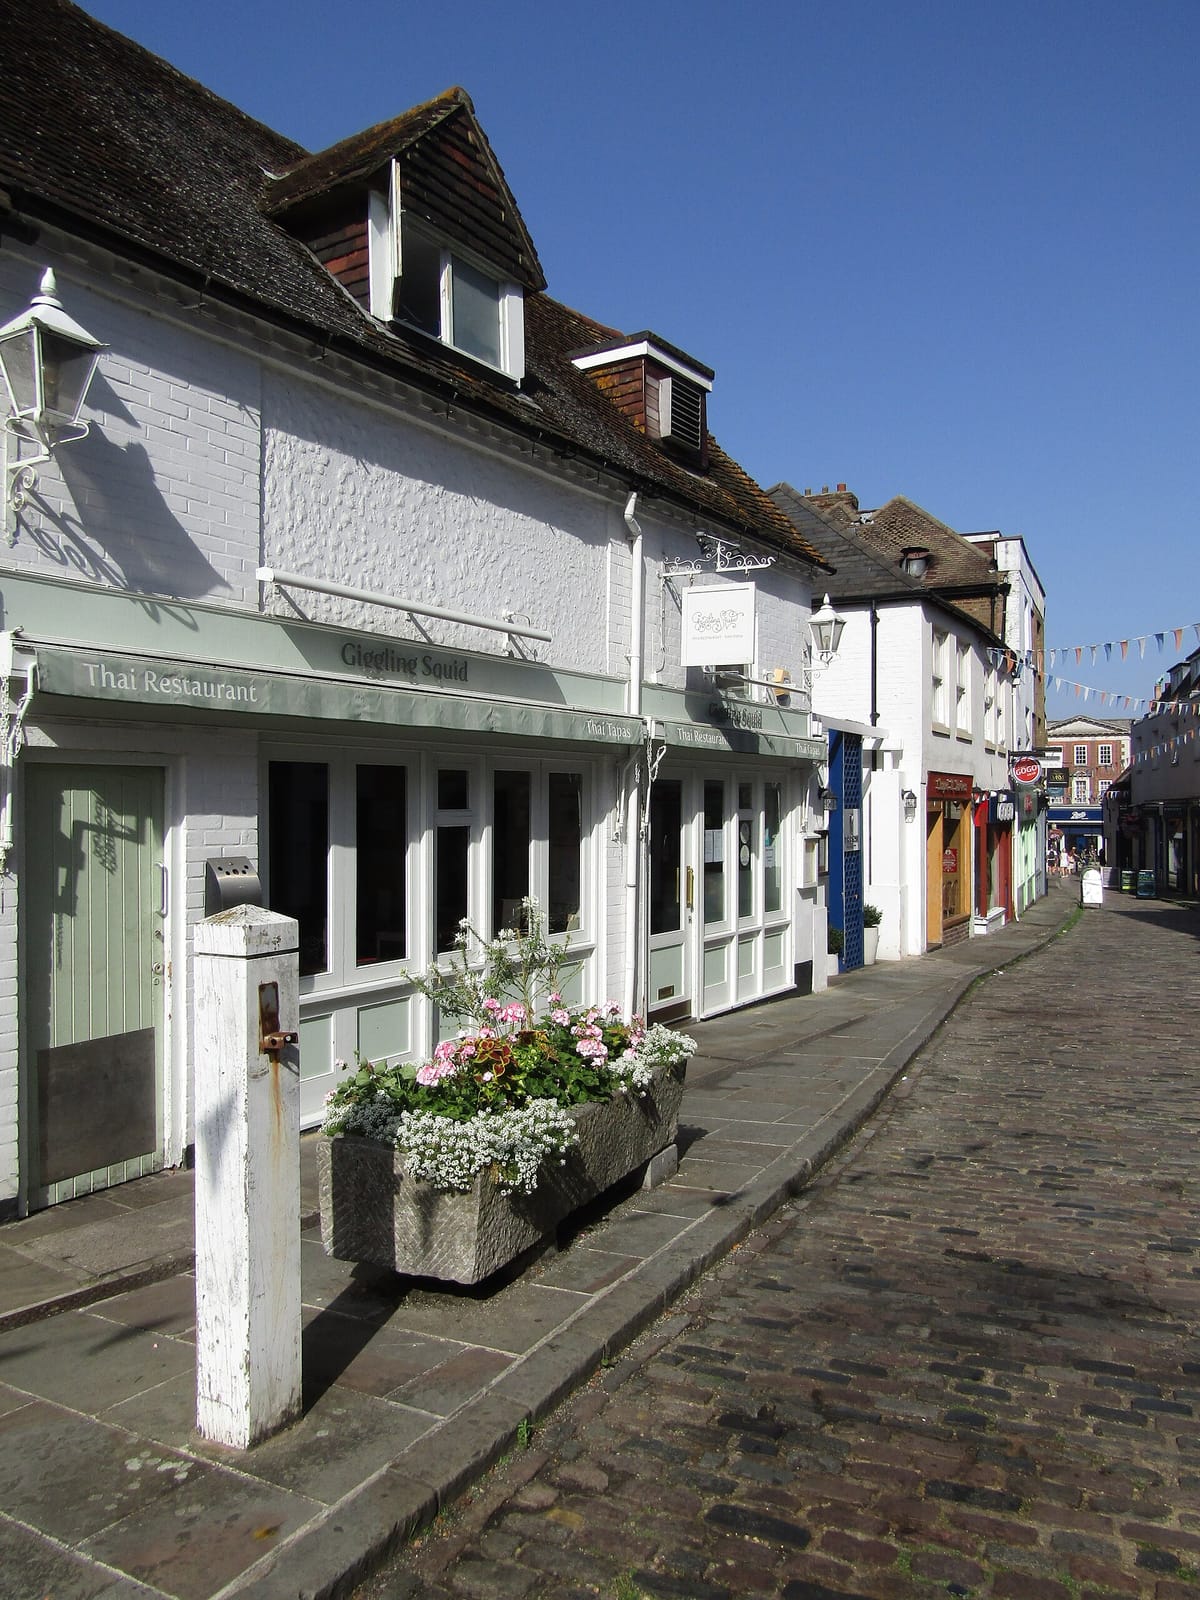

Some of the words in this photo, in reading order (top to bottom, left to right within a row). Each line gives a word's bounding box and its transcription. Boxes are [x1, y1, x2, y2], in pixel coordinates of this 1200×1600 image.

[341, 642, 418, 676] Giggling
[422, 655, 469, 682] Squid
[83, 663, 138, 691] Thai
[144, 670, 258, 702] Restaurant
[586, 718, 605, 736] Thai
[607, 722, 631, 741] Tapas
[677, 727, 693, 741] Thai
[694, 730, 729, 745] Restauran
[796, 742, 808, 753] Thai
[1016, 764, 1038, 776] GOGO
